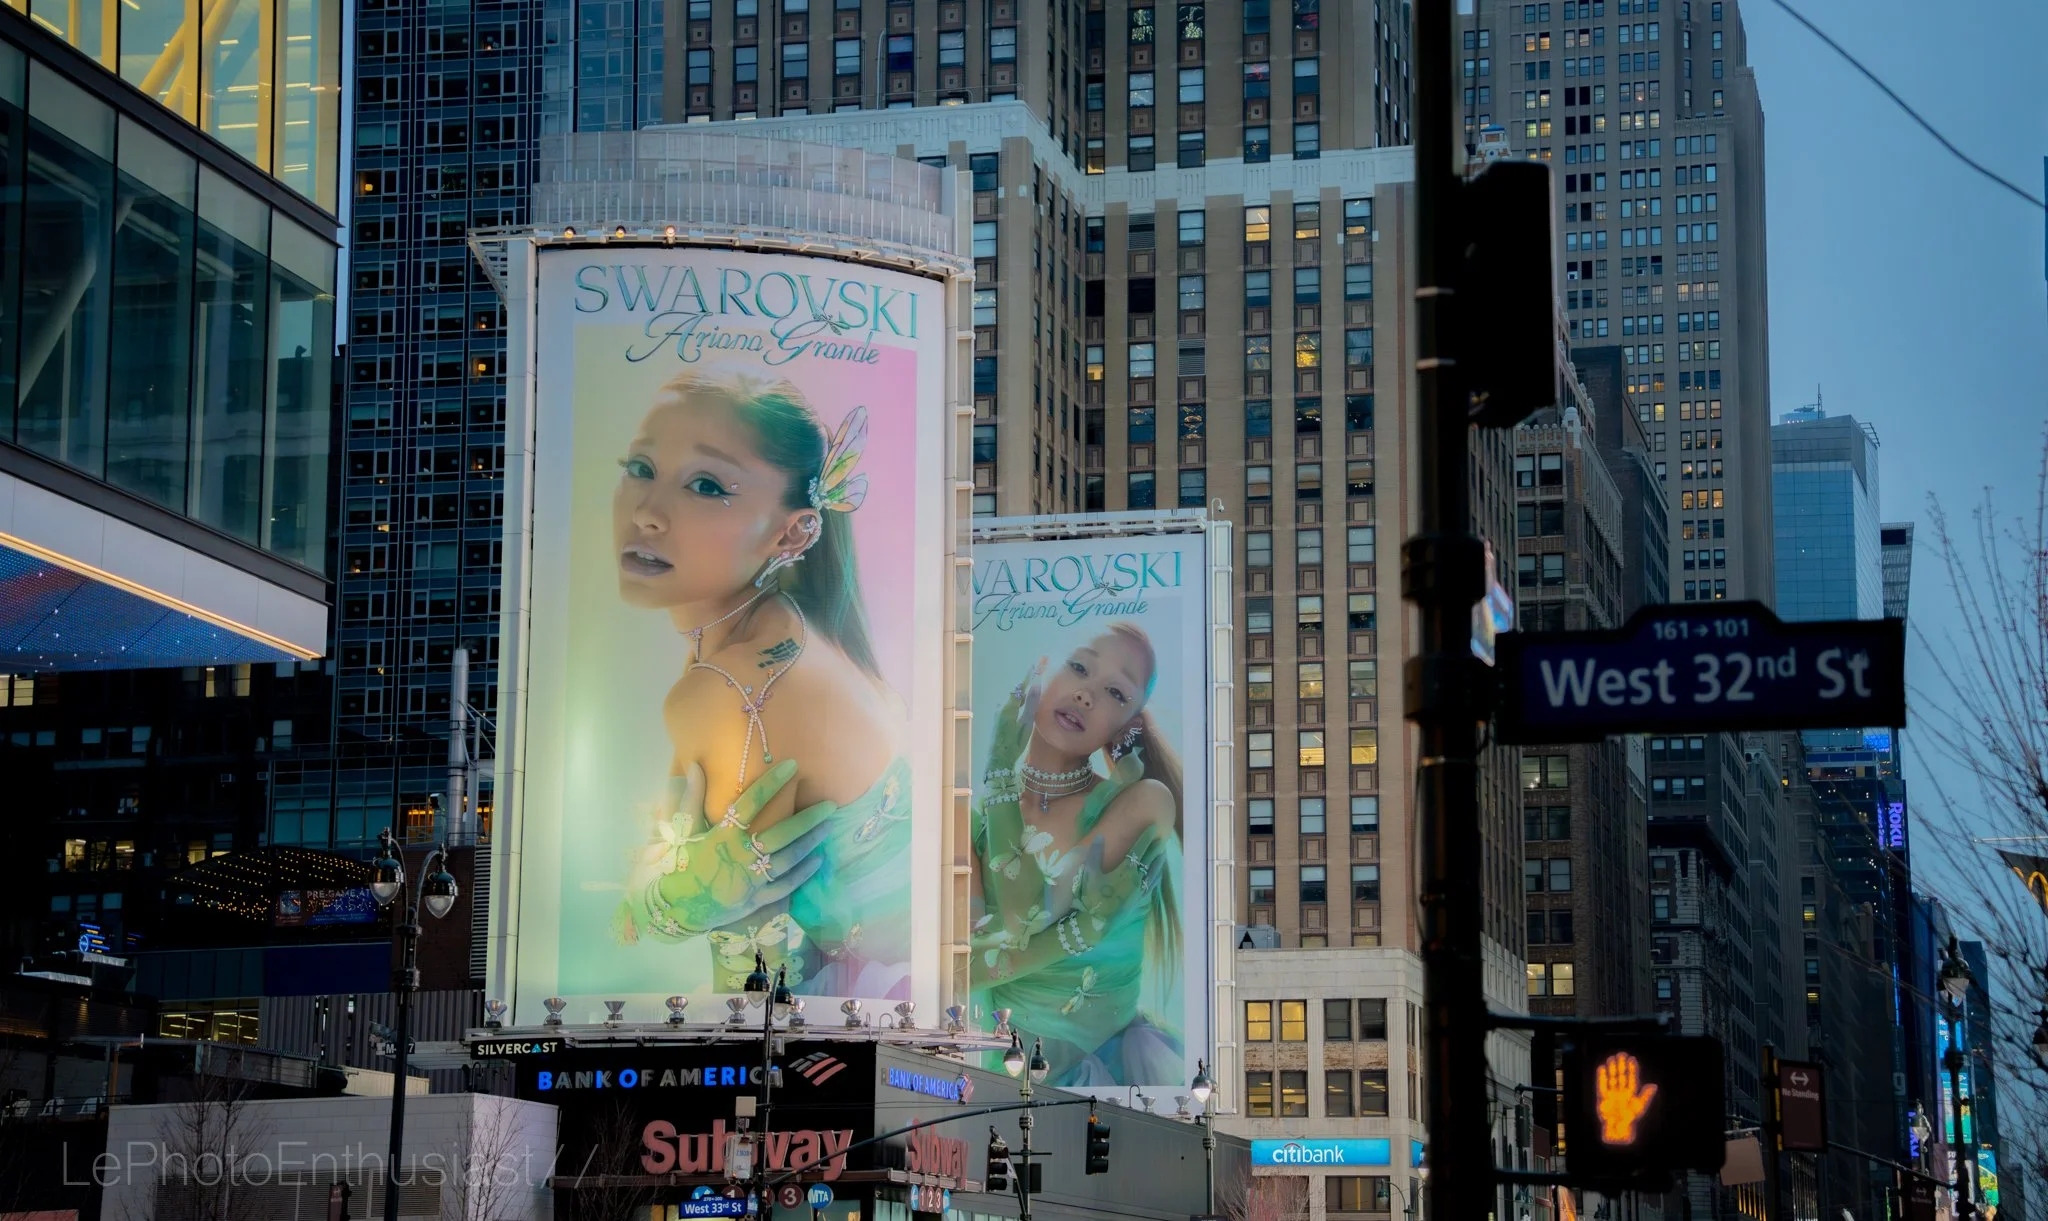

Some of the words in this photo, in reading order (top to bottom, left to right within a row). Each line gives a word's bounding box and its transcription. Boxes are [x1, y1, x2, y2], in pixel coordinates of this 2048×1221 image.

[574, 264, 920, 339] SWAROVSKI
[626, 311, 764, 364] Ariana
[763, 315, 880, 366] Grande
[956, 551, 1185, 595] WAROVSKI
[1057, 588, 1149, 627] Grande
[1652, 619, 1689, 641] 161
[1713, 617, 1749, 640] 101
[1540, 658, 1676, 708] West
[1693, 648, 1796, 704] 32nd
[1816, 648, 1871, 699] St
[1889, 802, 1904, 847] ROKU
[477, 1042, 558, 1056] SILVERCAST
[537, 1070, 613, 1091] BANK
[618, 1068, 655, 1089] OF
[659, 1066, 783, 1088] AMERIC
[888, 1067, 911, 1089] BANK
[912, 1074, 924, 1092] OF
[924, 1077, 960, 1101] AMERICA
[1781, 1088, 1791, 1096] No
[911, 1119, 969, 1189] Subway
[1272, 1143, 1345, 1164] citibank
[684, 1203, 709, 1214] West
[711, 1202, 730, 1213] 33rd
[731, 1203, 742, 1213] St
[784, 1187, 796, 1205] 3
[808, 1188, 829, 1204] MTA
